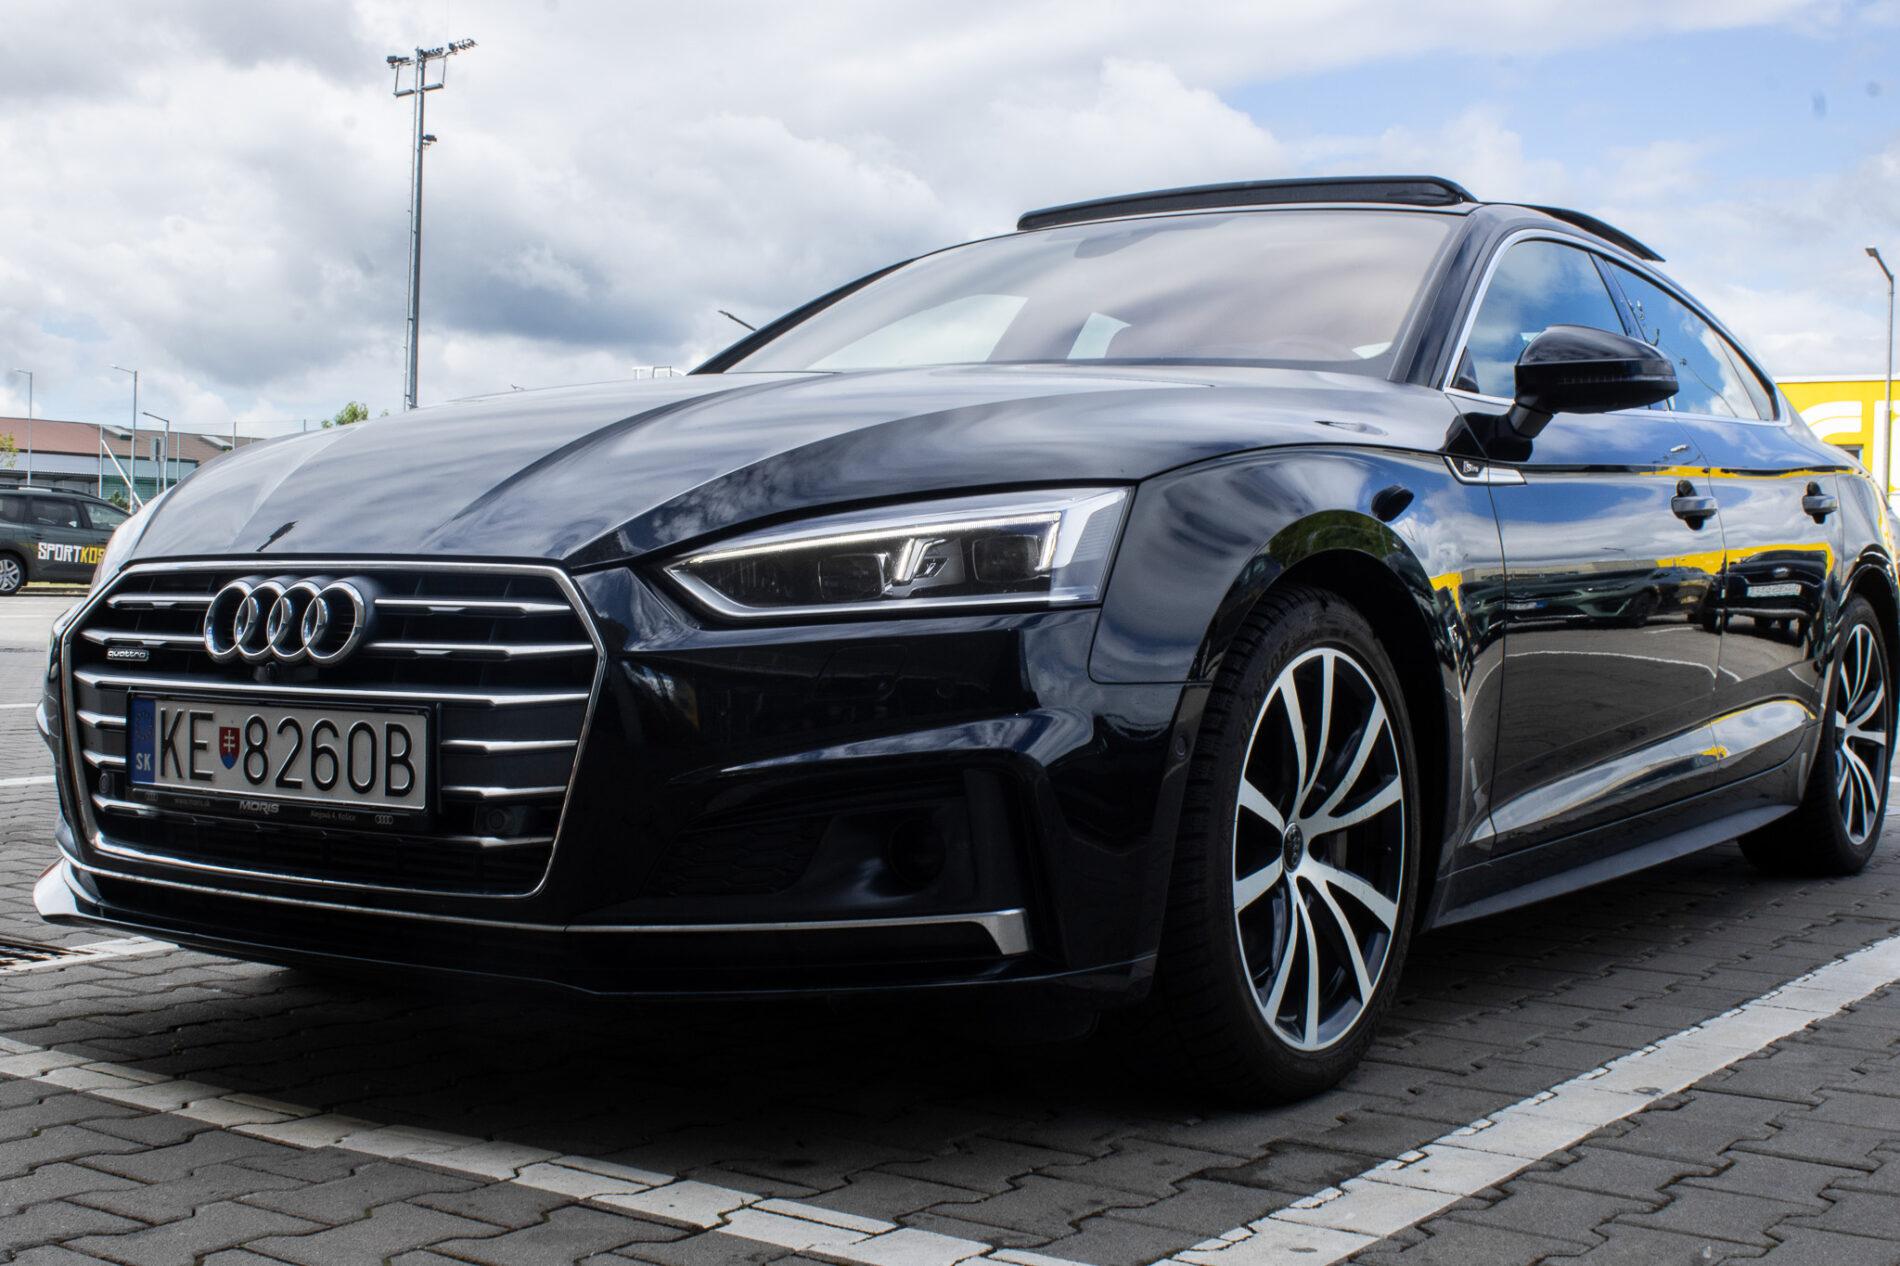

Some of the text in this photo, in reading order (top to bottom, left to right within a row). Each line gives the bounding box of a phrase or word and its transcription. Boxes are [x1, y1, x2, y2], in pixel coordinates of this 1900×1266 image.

[107, 650, 146, 658] quattro
[159, 707, 215, 782] KE
[135, 752, 152, 771] SK
[239, 799, 280, 815] MORIS
